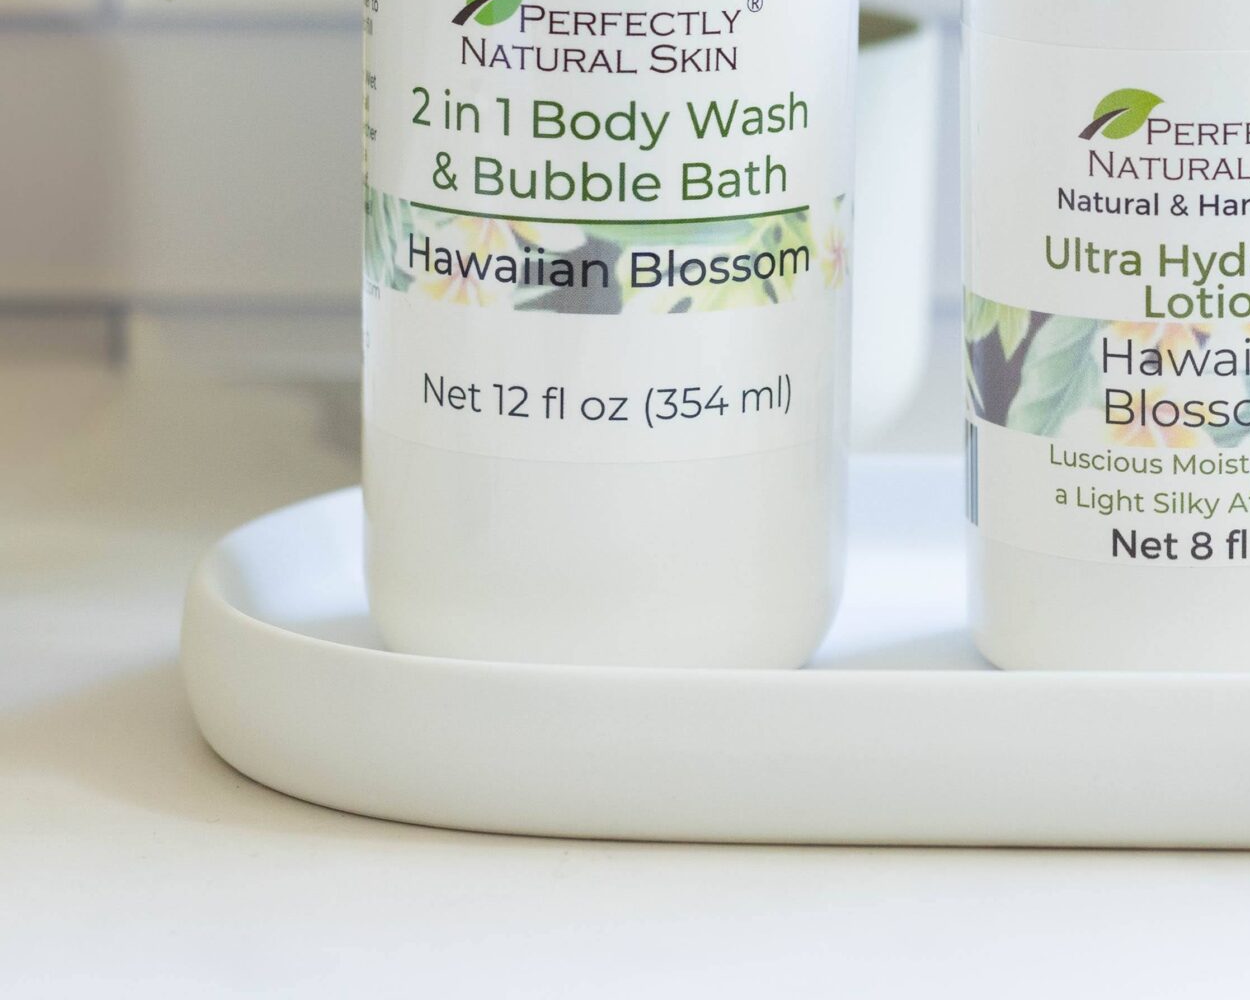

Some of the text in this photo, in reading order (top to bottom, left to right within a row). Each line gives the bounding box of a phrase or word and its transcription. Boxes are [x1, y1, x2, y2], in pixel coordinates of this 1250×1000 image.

[520, 5, 741, 36] PERFECTLY
[462, 36, 736, 73] NATURAL SKIN
[413, 87, 807, 151] 2 in 1 Body Wash
[433, 152, 786, 201] & Bubble Bath
[1059, 188, 1158, 215] Natural
[1171, 194, 1188, 216] &
[409, 233, 809, 288] Hawaiian Blossom
[1046, 236, 1141, 276] Ultra
[425, 373, 790, 428] Net 12 fl oz (354 ml)
[1051, 444, 1162, 474] Luscious
[1056, 489, 1067, 504] a
[1077, 487, 1144, 515] Light
[1154, 492, 1219, 519] Silky
[1113, 529, 1178, 560] Net
[1191, 532, 1213, 560] 8
[1226, 529, 1246, 559] fl
